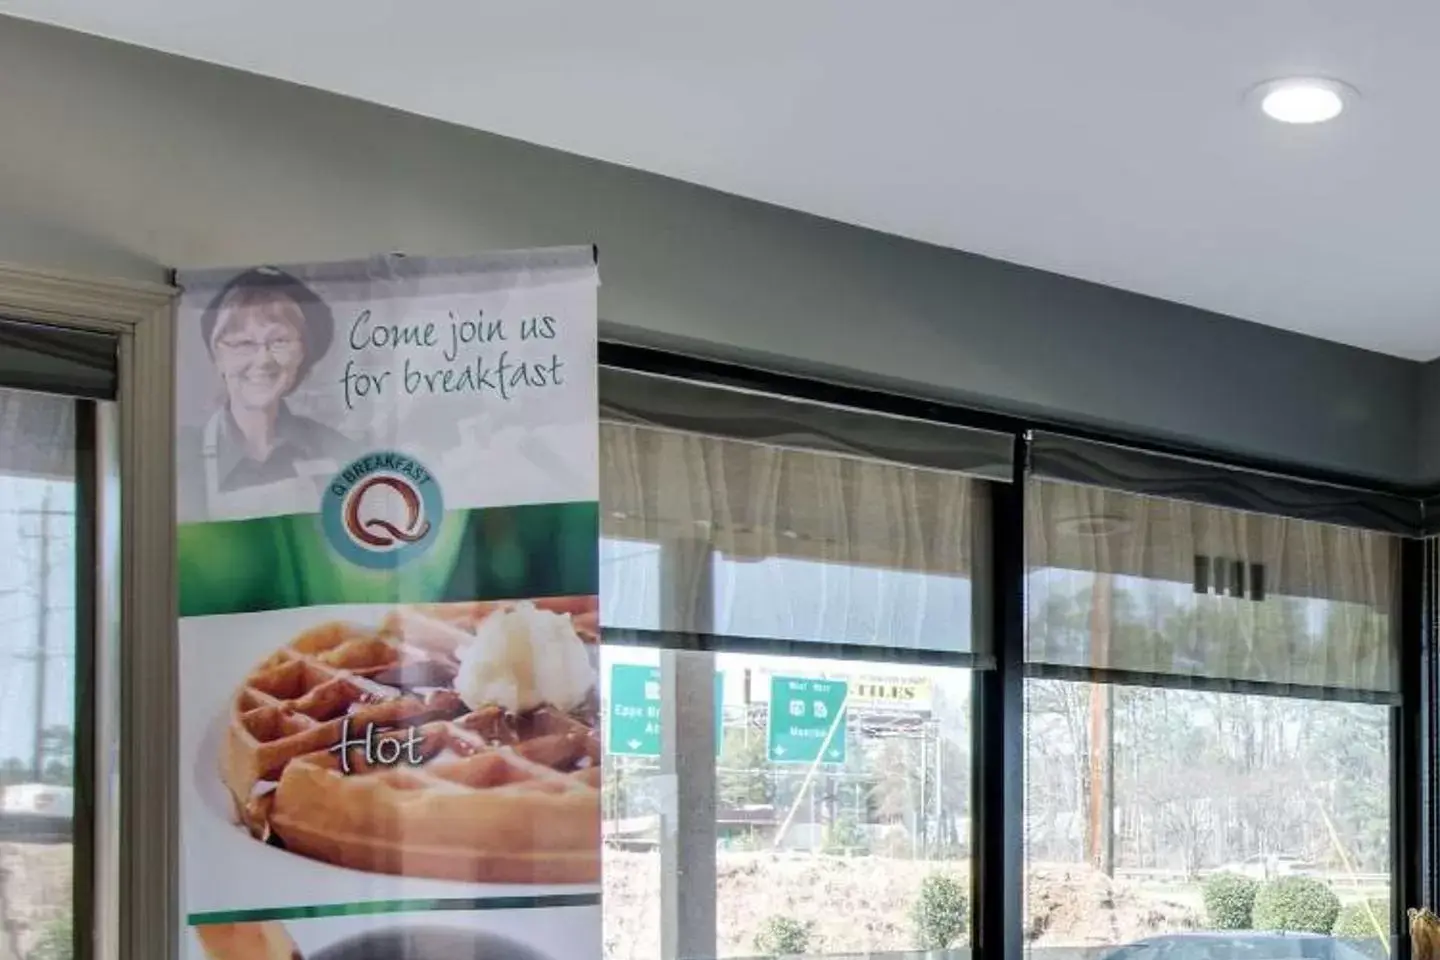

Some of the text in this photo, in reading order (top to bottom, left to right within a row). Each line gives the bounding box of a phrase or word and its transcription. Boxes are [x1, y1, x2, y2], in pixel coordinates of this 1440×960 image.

[350, 309, 557, 361] Come join us
[340, 351, 564, 409] for breakfast
[341, 451, 431, 485] BREAKFAST
[345, 476, 431, 546] Q
[329, 719, 425, 774] Hot
